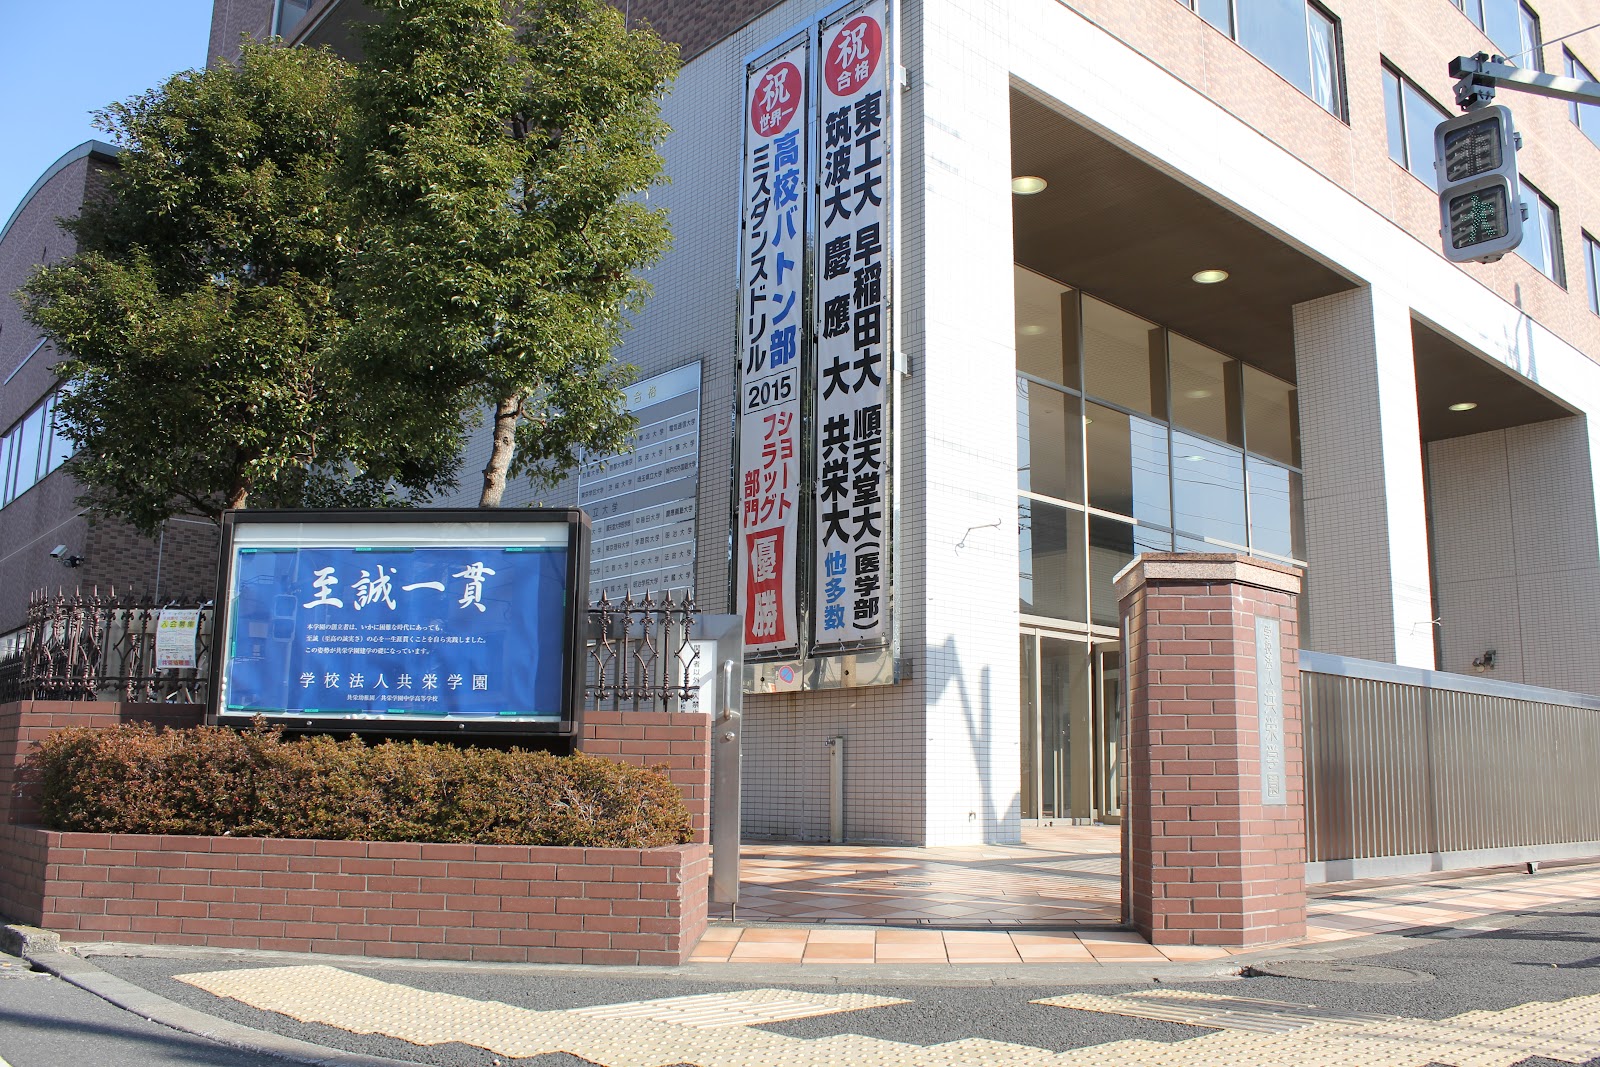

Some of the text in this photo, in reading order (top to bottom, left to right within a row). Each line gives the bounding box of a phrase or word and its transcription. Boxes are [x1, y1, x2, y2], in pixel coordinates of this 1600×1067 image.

[834, 22, 870, 70] 祝
[758, 67, 791, 112] 祝
[836, 62, 870, 92] 合格
[759, 106, 793, 133] 世界一
[853, 89, 882, 216] 東工大
[746, 143, 771, 376] ミスダンスドリル
[769, 128, 800, 370] 高校バトン部
[852, 221, 882, 394] 早稲田大
[748, 375, 791, 409] 2015
[820, 104, 852, 631] 筑波大 慶應大 共栄大 他多数
[777, 410, 794, 520] ショート
[743, 468, 761, 529] 部門
[303, 561, 496, 613] 至誠一貫
[751, 534, 778, 638] 優勝
[299, 671, 488, 691] 学校法人共栄学園
